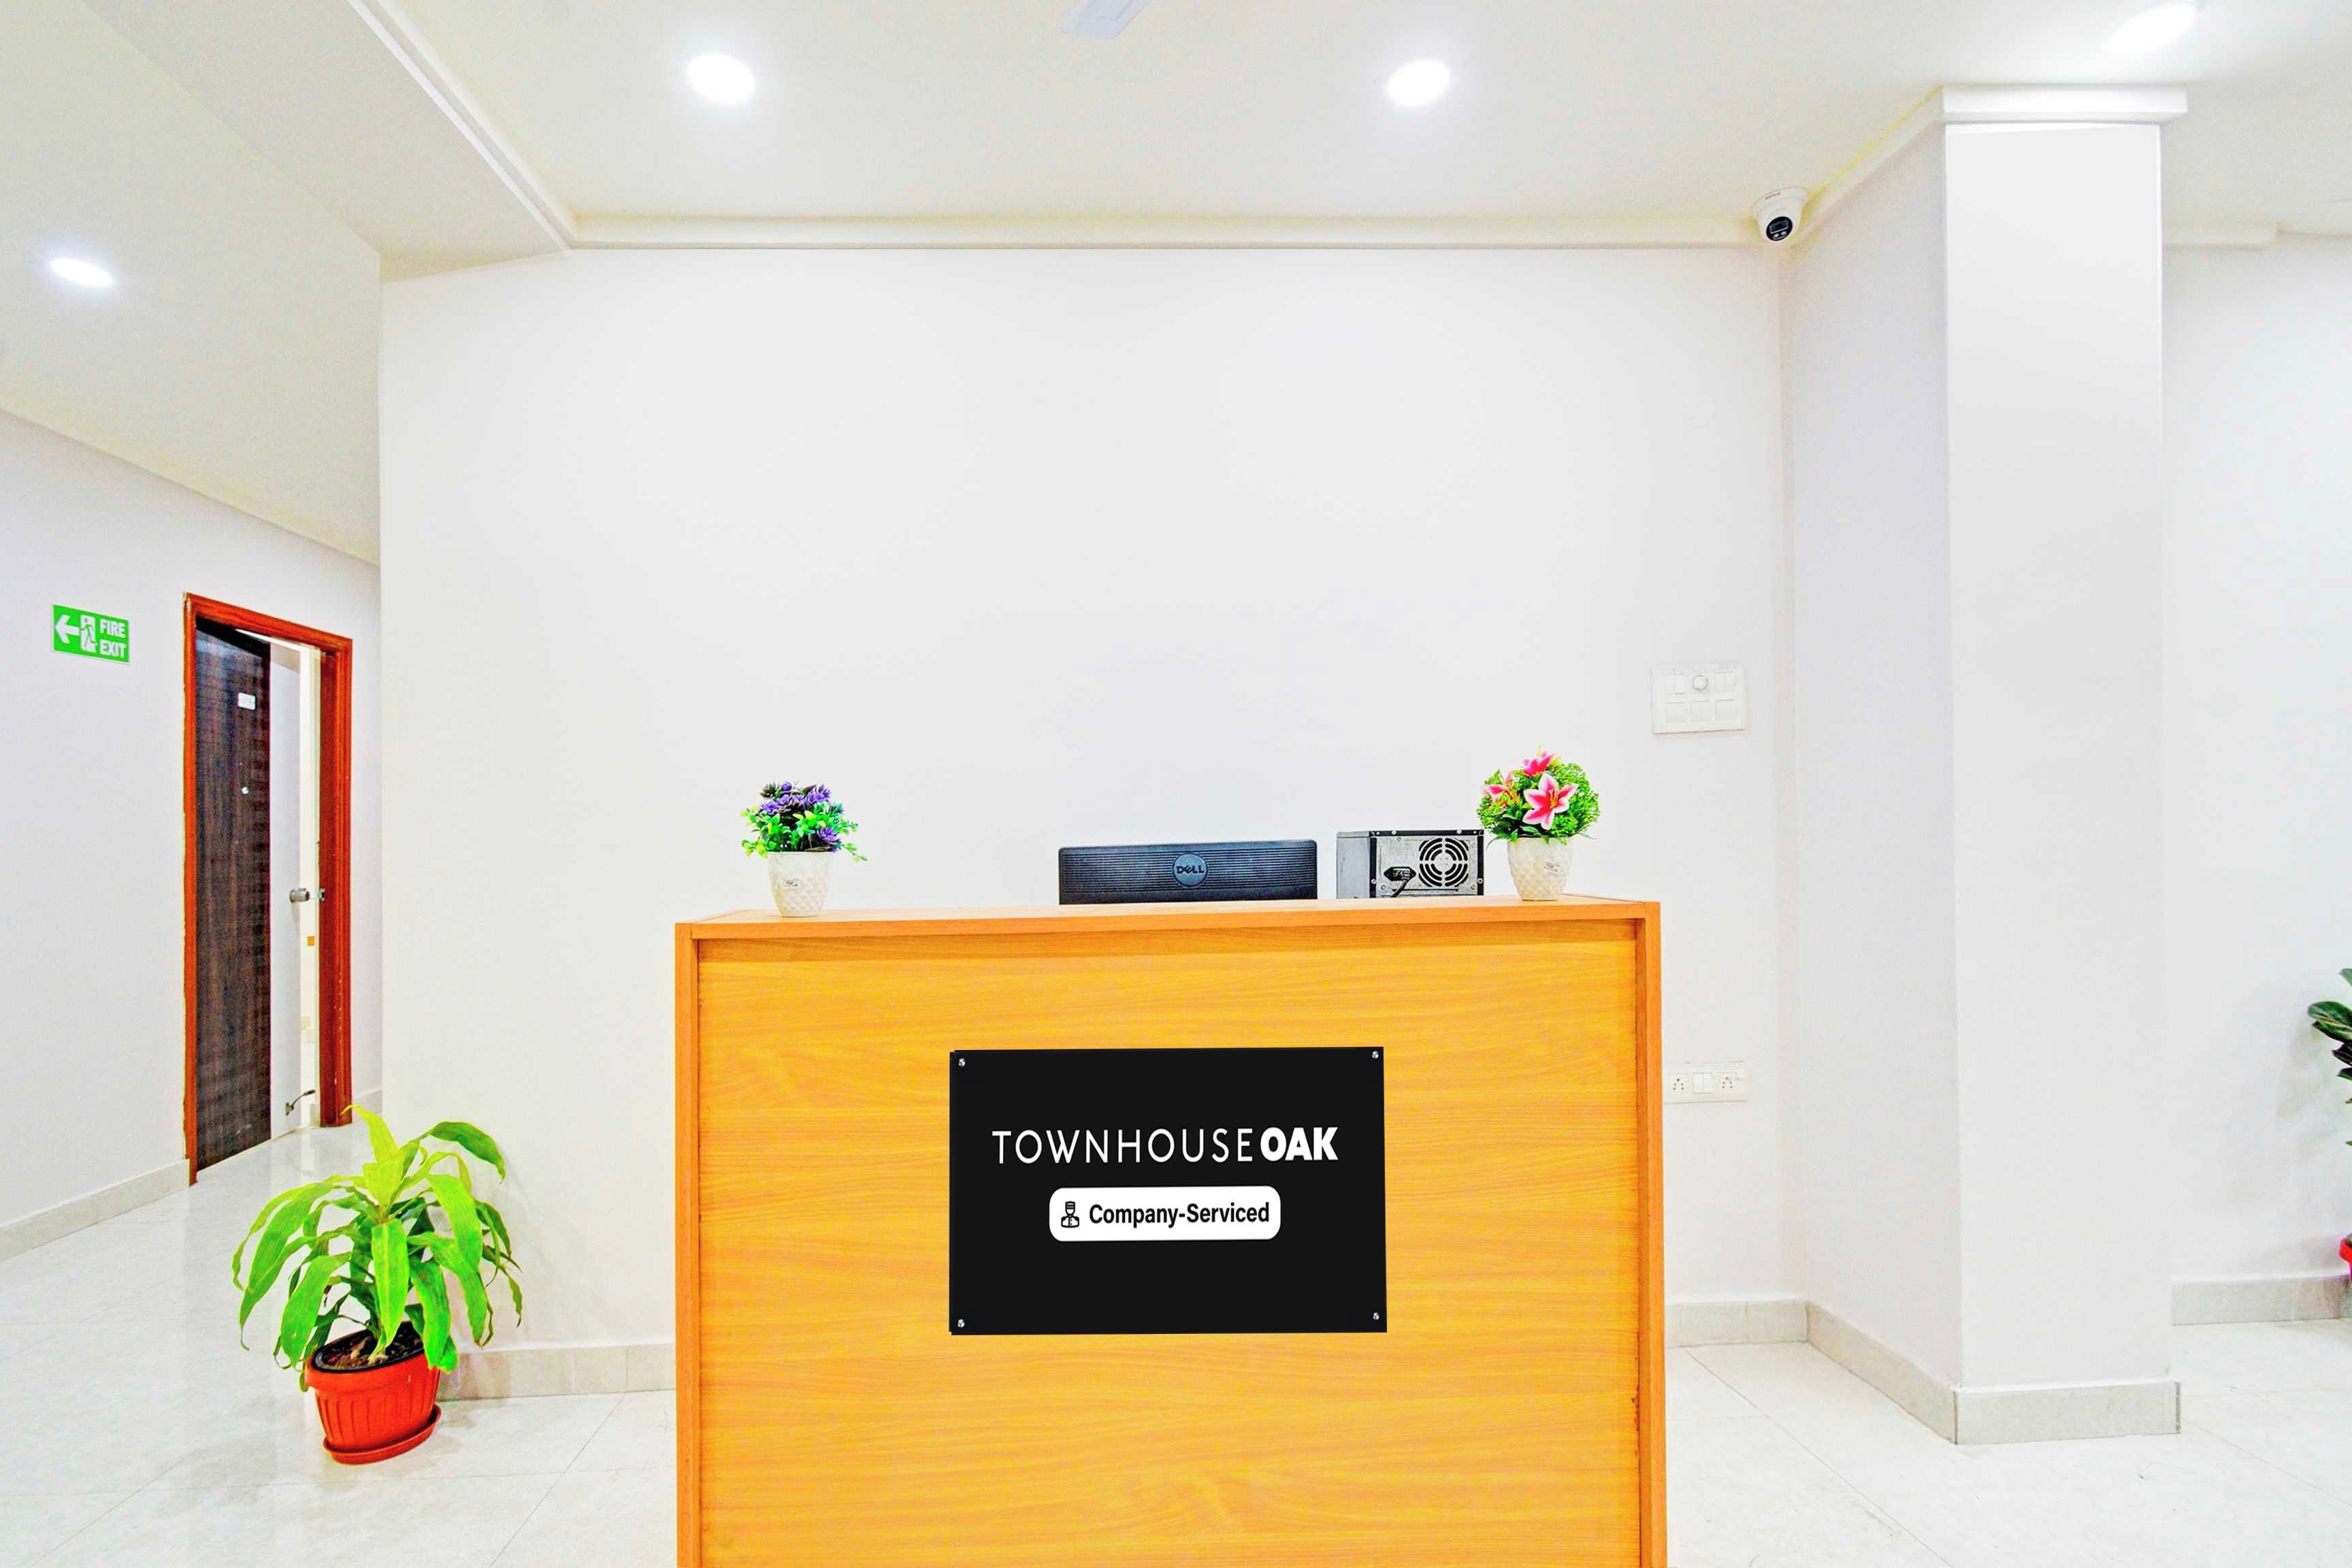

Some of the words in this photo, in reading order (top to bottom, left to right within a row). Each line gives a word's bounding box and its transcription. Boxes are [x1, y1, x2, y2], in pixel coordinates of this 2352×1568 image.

[99, 618, 125, 638] FIRE
[99, 639, 126, 658] EXIT
[1177, 865, 1205, 874] DELL
[992, 1128, 1253, 1164] TOWNHOUSE
[1260, 1126, 1339, 1162] OAK
[1089, 1201, 1270, 1229] Company-Serviced
